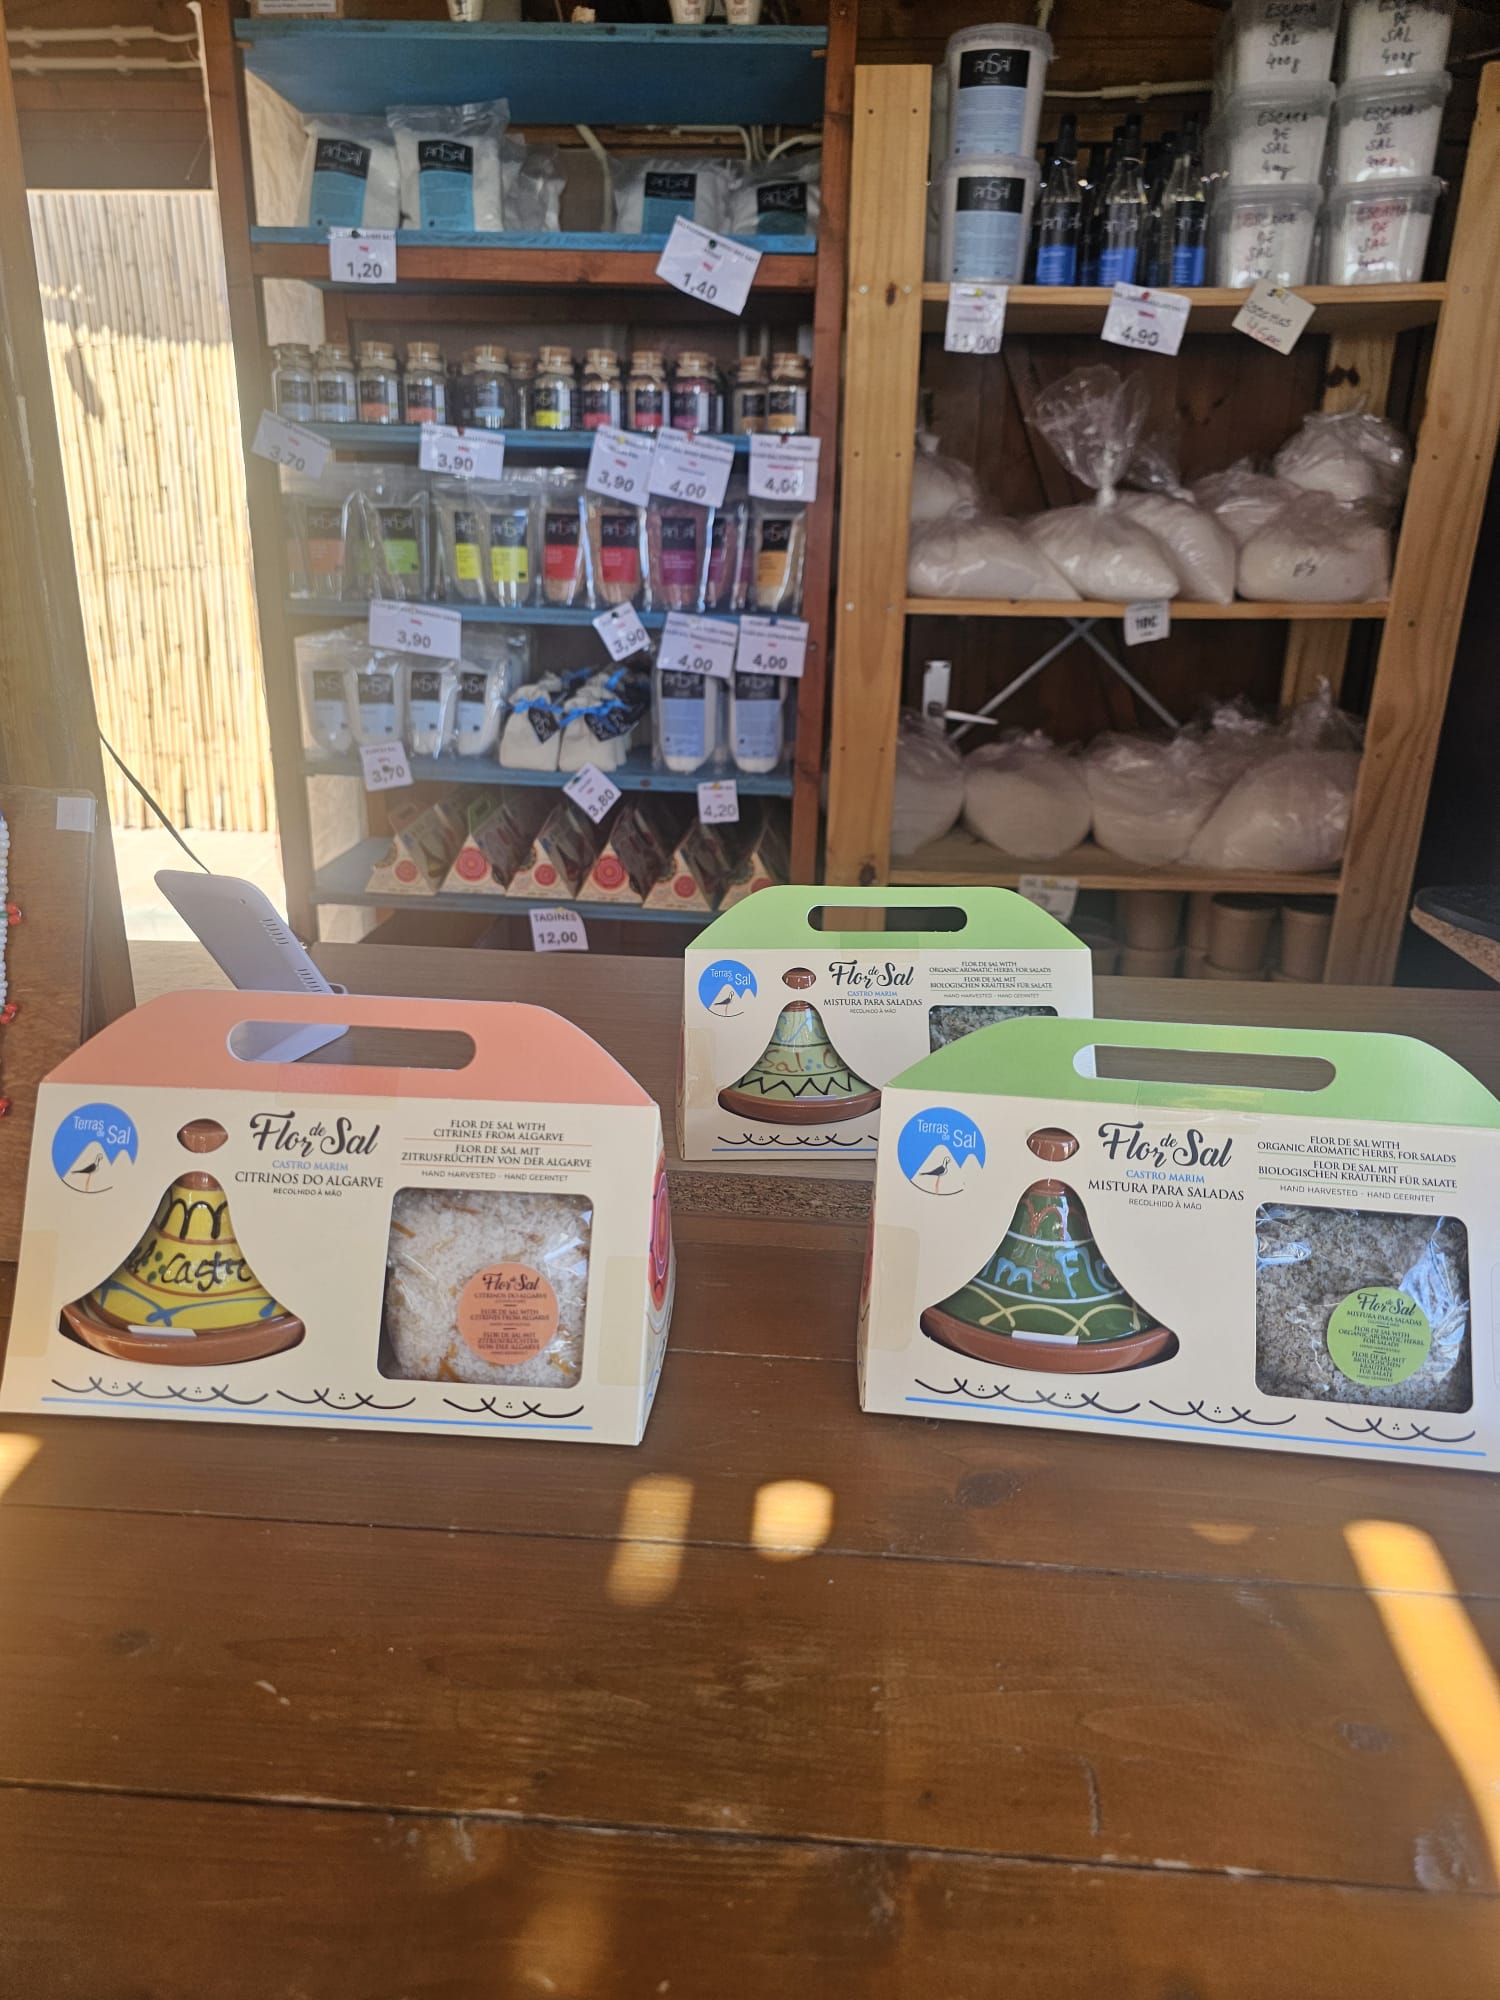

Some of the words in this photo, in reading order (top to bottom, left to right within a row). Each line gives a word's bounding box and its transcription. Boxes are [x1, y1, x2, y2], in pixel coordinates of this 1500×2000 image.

[1268, 32, 1300, 47] SAL
[1381, 26, 1414, 43] SAL
[1262, 142, 1291, 154] SAL
[347, 262, 382, 280] 1,20
[683, 273, 717, 299] 1,40
[1121, 326, 1159, 346] 4,90
[437, 453, 474, 472] 3,90
[598, 471, 635, 493] 3,90
[669, 479, 706, 500] 4,00
[397, 629, 431, 649] 3,90
[613, 628, 646, 654] 3,90
[678, 654, 713, 672] 4,00
[752, 653, 788, 670] 4,00
[703, 804, 737, 818] 4,20
[538, 931, 578, 946] 12,00
[735, 973, 750, 985] Sal
[829, 959, 872, 989] Flor
[868, 966, 879, 976] de
[876, 962, 914, 987] Sal
[73, 1115, 104, 1131] Terras
[107, 1125, 131, 1145] Sal
[250, 1110, 314, 1158] Flor
[309, 1121, 326, 1137] de
[320, 1117, 380, 1155] Sal
[451, 1119, 477, 1129] FLOR
[480, 1121, 494, 1129] DE
[497, 1121, 514, 1130] SAL
[517, 1122, 546, 1131] WITH
[917, 1119, 949, 1134] Terras
[952, 1129, 976, 1149] Sal
[433, 1128, 482, 1139] CITRINES
[485, 1130, 516, 1140] FROM
[518, 1131, 565, 1142] ALGARVE
[1310, 1136, 1335, 1146] FLOR
[1338, 1137, 1352, 1147] DE
[1353, 1138, 1371, 1148] SAL
[1372, 1139, 1400, 1149] WITH
[455, 1144, 481, 1154] FLOR
[484, 1145, 498, 1154] DE
[500, 1146, 518, 1155] SAL
[520, 1147, 541, 1156] MIT
[1098, 1121, 1167, 1168] Flor
[1160, 1133, 1178, 1148] de
[1173, 1129, 1233, 1168] Sal
[1257, 1141, 1305, 1153] ORGANIC
[1307, 1145, 1360, 1157] AROMATIC
[1362, 1149, 1396, 1160] HERBS,
[1398, 1151, 1418, 1161] FOR
[1420, 1153, 1456, 1163] SALADS
[272, 1160, 311, 1170] CASTRO
[314, 1162, 349, 1171] MARIM
[401, 1151, 495, 1164] ZITRUSFRÜCHTEN
[498, 1156, 521, 1165] VON
[525, 1157, 546, 1166] DER
[547, 1157, 592, 1168] ALGARVE
[1313, 1160, 1340, 1171] FLOR
[1343, 1162, 1357, 1172] DE
[1358, 1163, 1377, 1173] SAL
[1378, 1164, 1398, 1174] MIT
[235, 1171, 299, 1185] CITRINOS
[302, 1174, 324, 1185] DO
[326, 1175, 384, 1188] ALGARVE
[448, 1171, 497, 1179] HARVESTED
[504, 1172, 528, 1180] HAND
[1126, 1169, 1166, 1181] CASTRO
[1169, 1173, 1205, 1183] MARIM
[1258, 1165, 1338, 1179] BIOLOGISCHEN
[1341, 1170, 1396, 1184] KRÄUTERN
[1399, 1174, 1420, 1186] FÜR
[1422, 1177, 1457, 1188] SALATE
[273, 1187, 317, 1196] RECOLHIDO
[325, 1188, 342, 1197] MÃO
[1088, 1179, 1148, 1194] MISTURA
[1152, 1184, 1184, 1197] PARA
[1187, 1187, 1244, 1201] SALADAS
[1280, 1184, 1305, 1193] HAND
[1308, 1186, 1358, 1197] HARVESTED
[1367, 1191, 1391, 1200] HAND
[1394, 1193, 1435, 1203] GEERNTET
[1129, 1198, 1173, 1208] RECOLHIDO
[1183, 1200, 1202, 1210] MÃO
[482, 1272, 511, 1290] Flor
[515, 1273, 540, 1291] Sal
[1357, 1292, 1386, 1311] Flor
[1389, 1298, 1417, 1316] Sal
